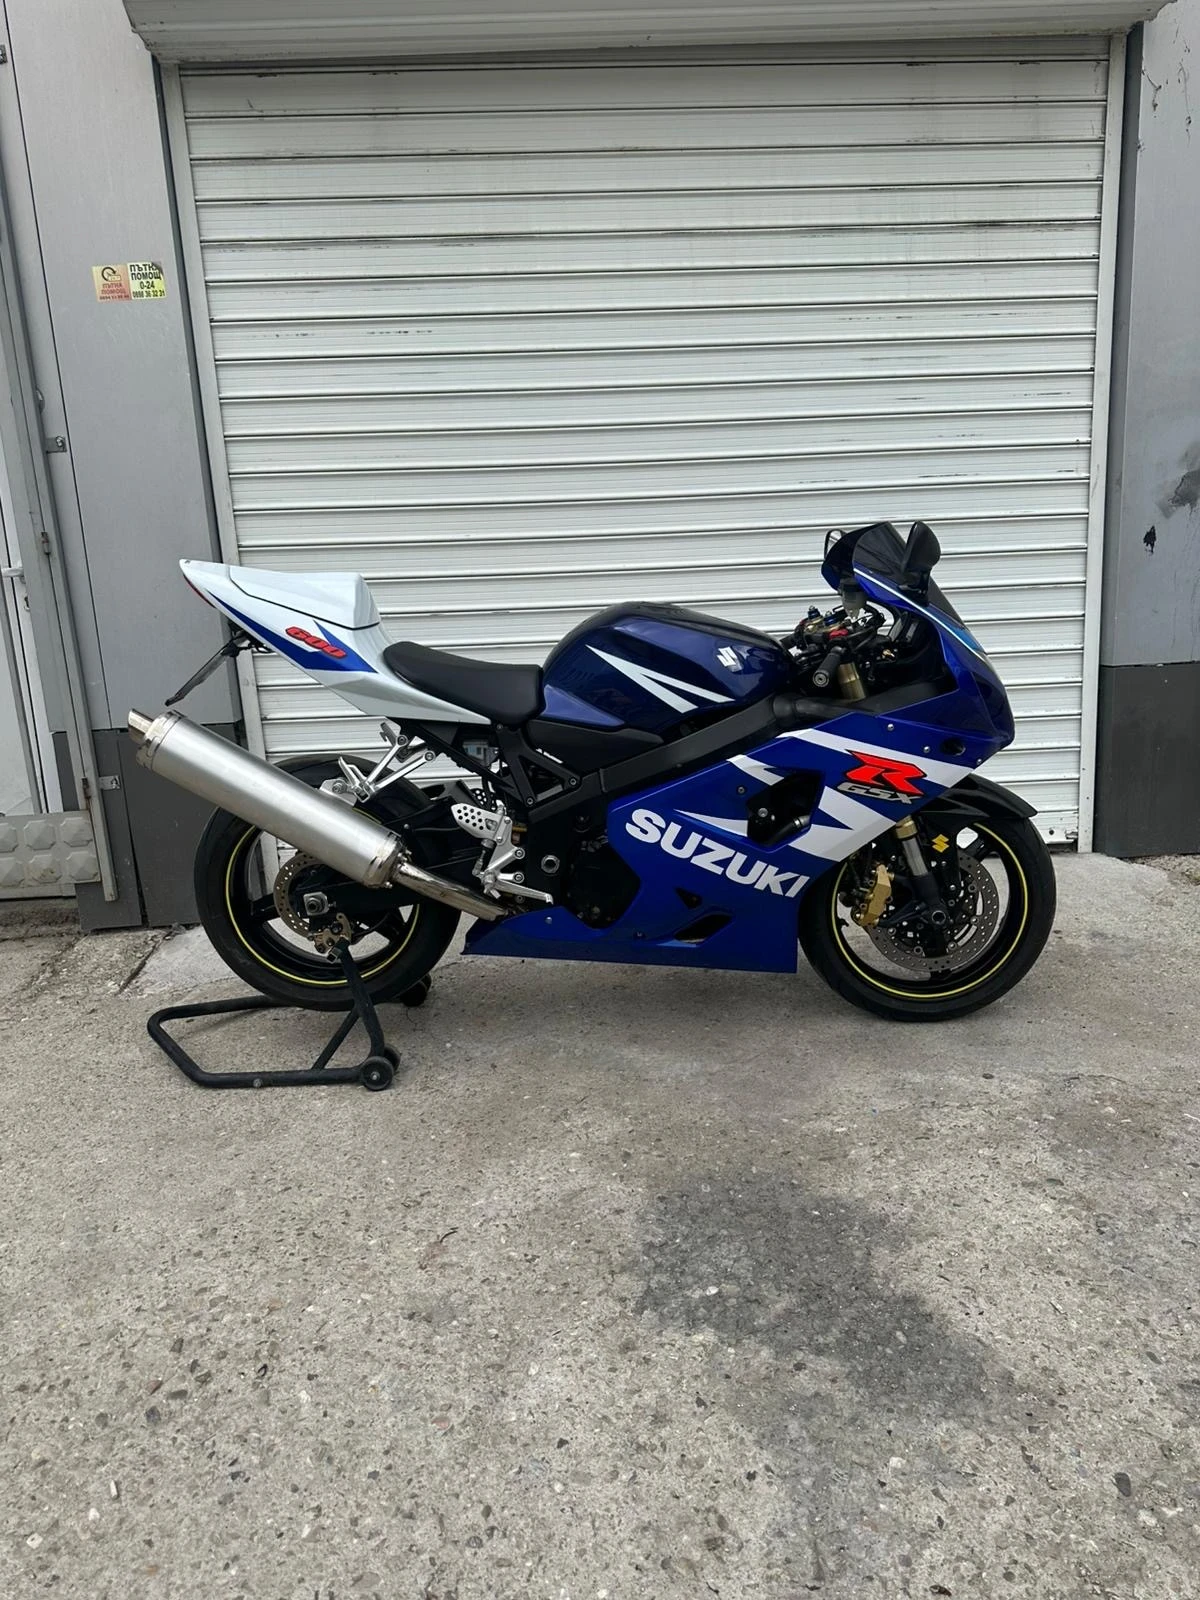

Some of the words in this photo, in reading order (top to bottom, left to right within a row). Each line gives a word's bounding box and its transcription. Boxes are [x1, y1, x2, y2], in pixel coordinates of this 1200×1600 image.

[131, 272, 161, 280] ПОМОЩ
[140, 281, 155, 289] 0-24
[285, 626, 347, 659] 600
[844, 749, 927, 796] R
[837, 782, 923, 804] GSX
[625, 808, 811, 898] SUZUKI
